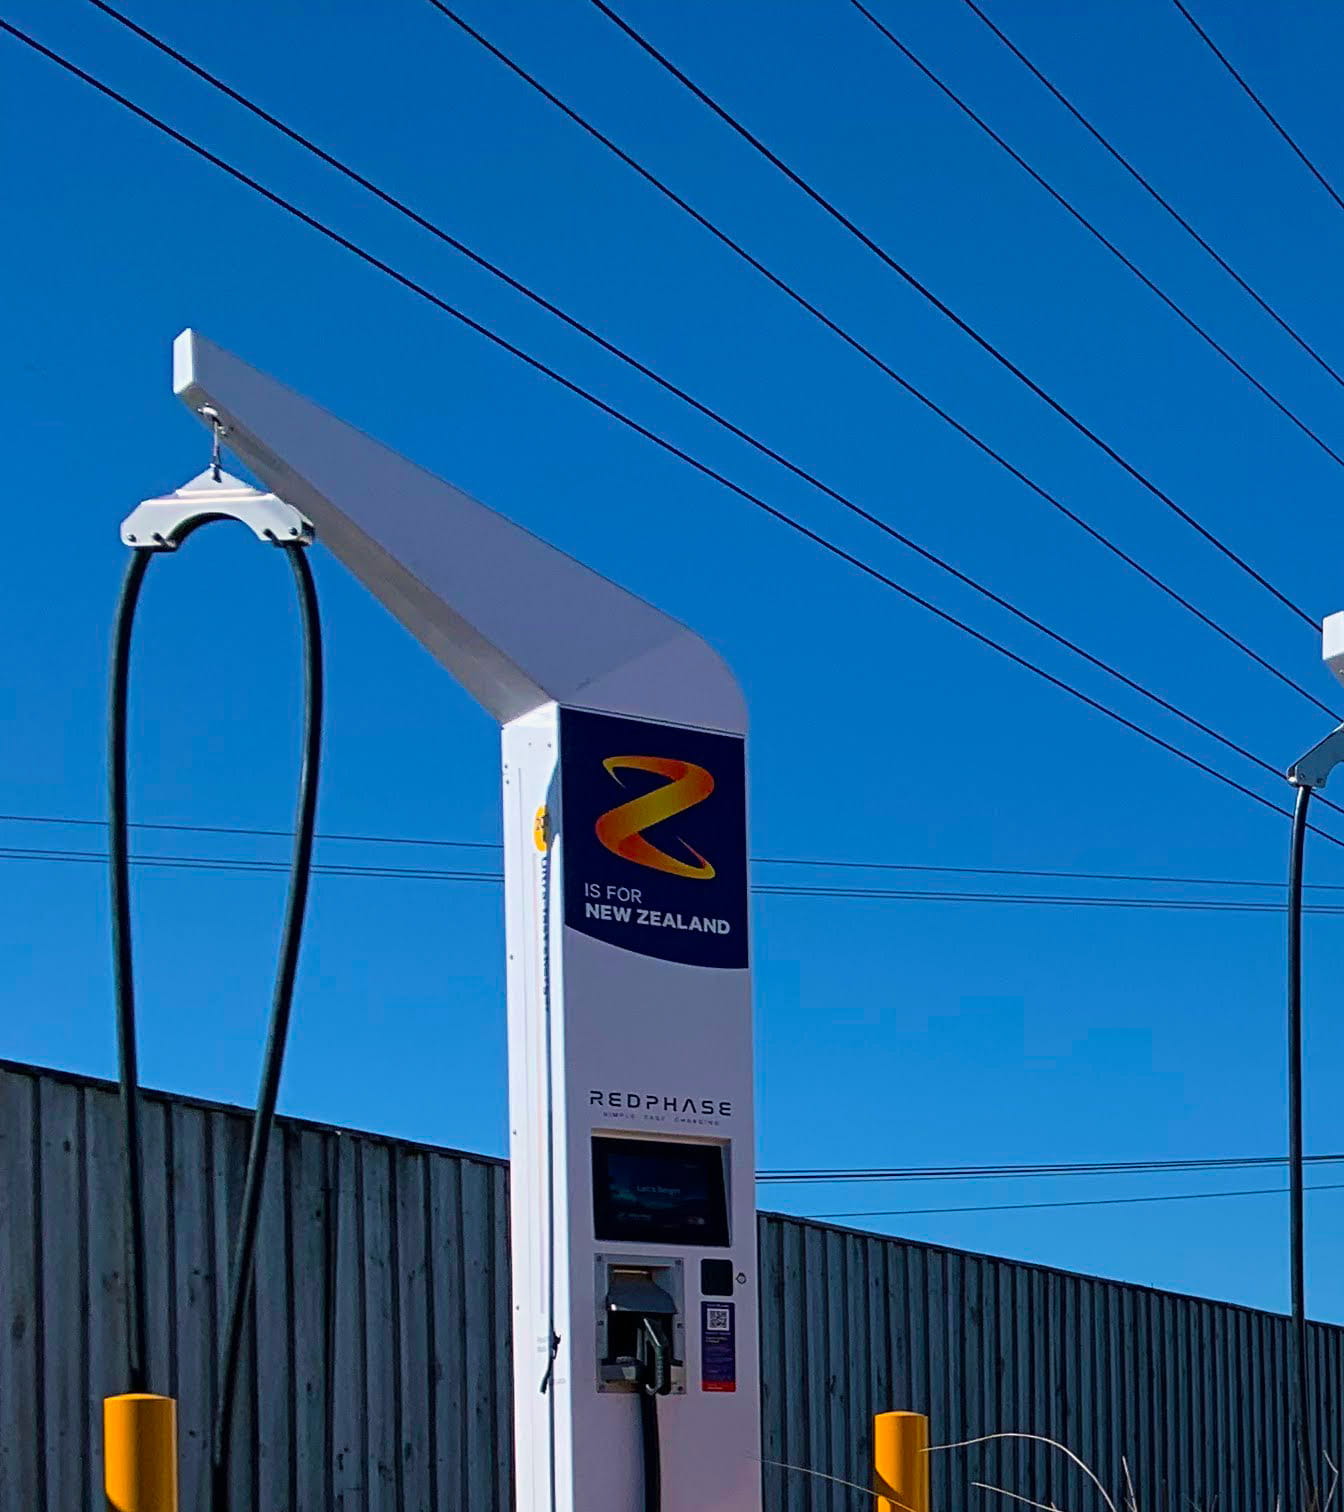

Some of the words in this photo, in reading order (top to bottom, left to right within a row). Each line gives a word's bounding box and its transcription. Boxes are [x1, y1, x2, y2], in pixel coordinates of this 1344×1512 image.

[584, 882, 601, 898] IS
[607, 886, 642, 904] FOR
[585, 902, 631, 923] NEW
[637, 908, 731, 935] ZEALAND
[590, 1090, 732, 1117] REDPHASE
